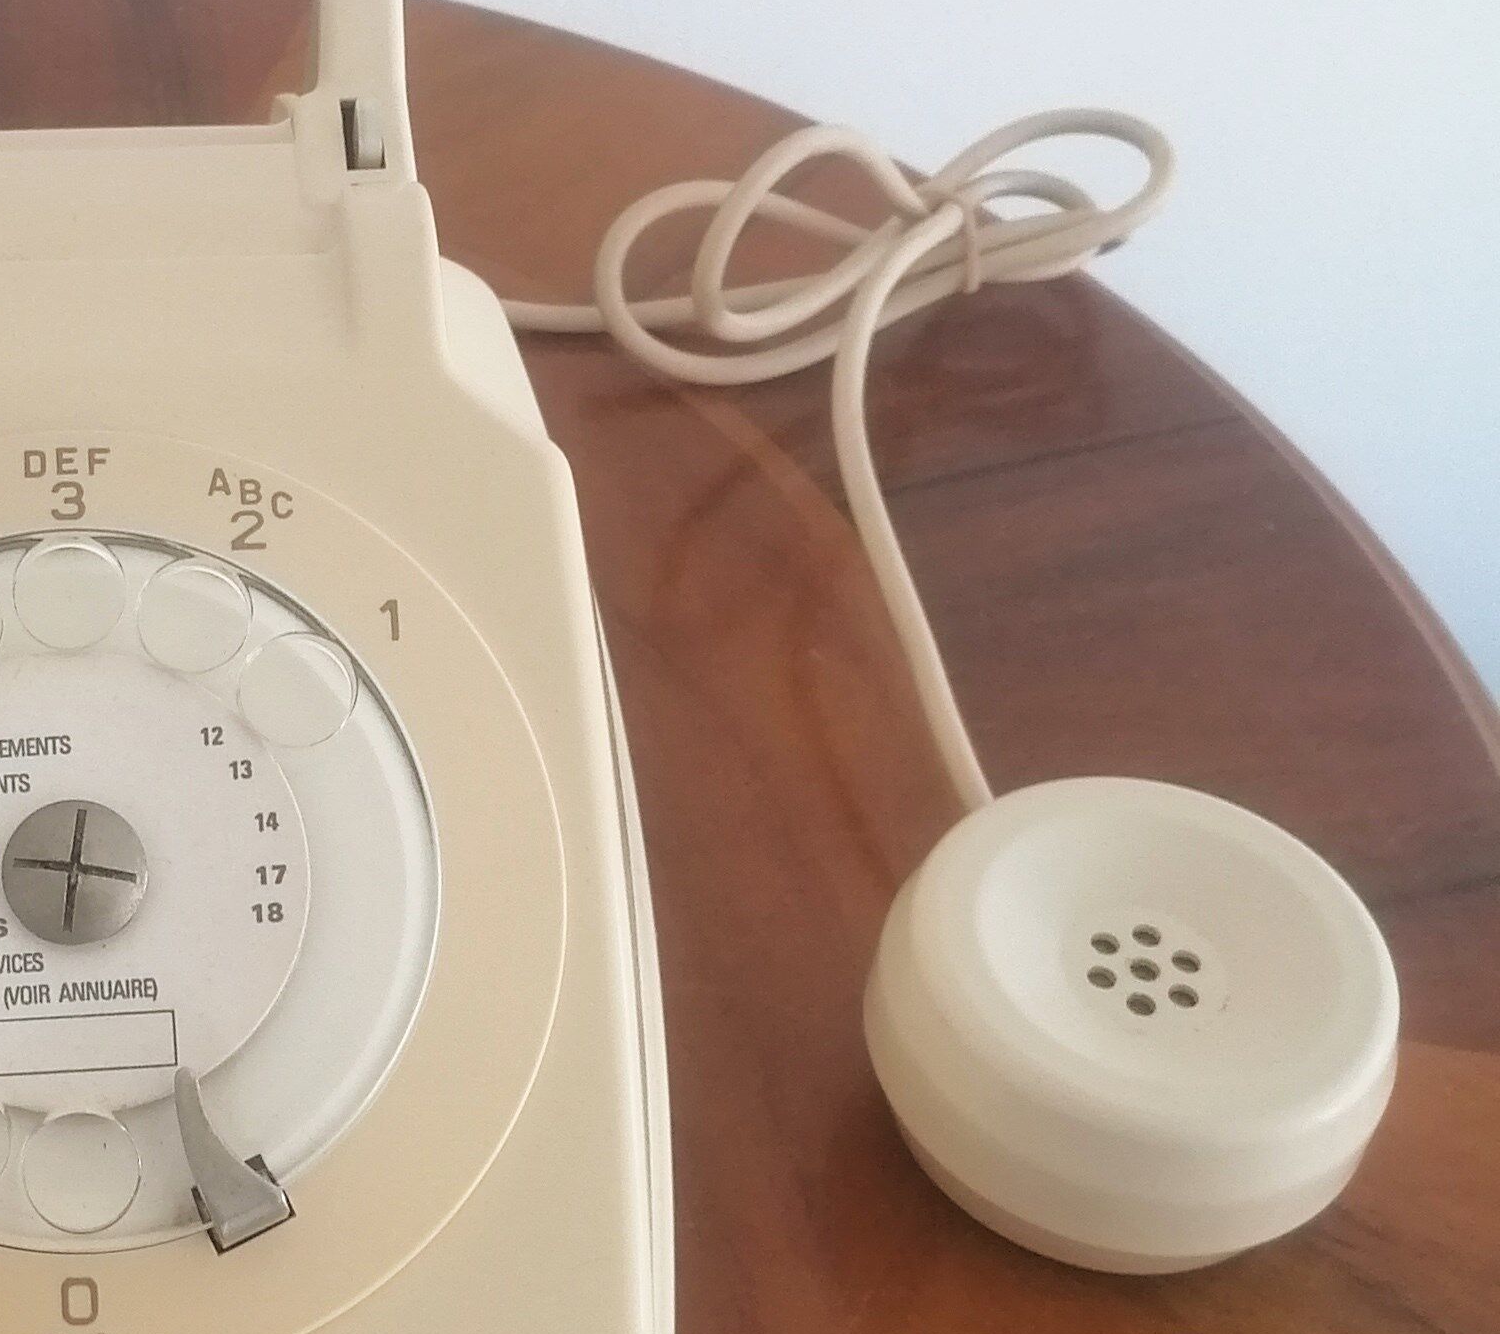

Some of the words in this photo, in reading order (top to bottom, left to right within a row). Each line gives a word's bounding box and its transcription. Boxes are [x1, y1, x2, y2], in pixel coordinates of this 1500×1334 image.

[51, 481, 86, 520] 3
[231, 510, 266, 551] 2
[380, 599, 399, 641] 1
[201, 726, 224, 746] 12
[229, 760, 252, 780] 13
[255, 812, 279, 832] 14
[256, 864, 286, 885] 17
[252, 902, 283, 923] 18
[4, 984, 50, 1010] (VOIR
[59, 978, 157, 1003] ANNUAIRE)
